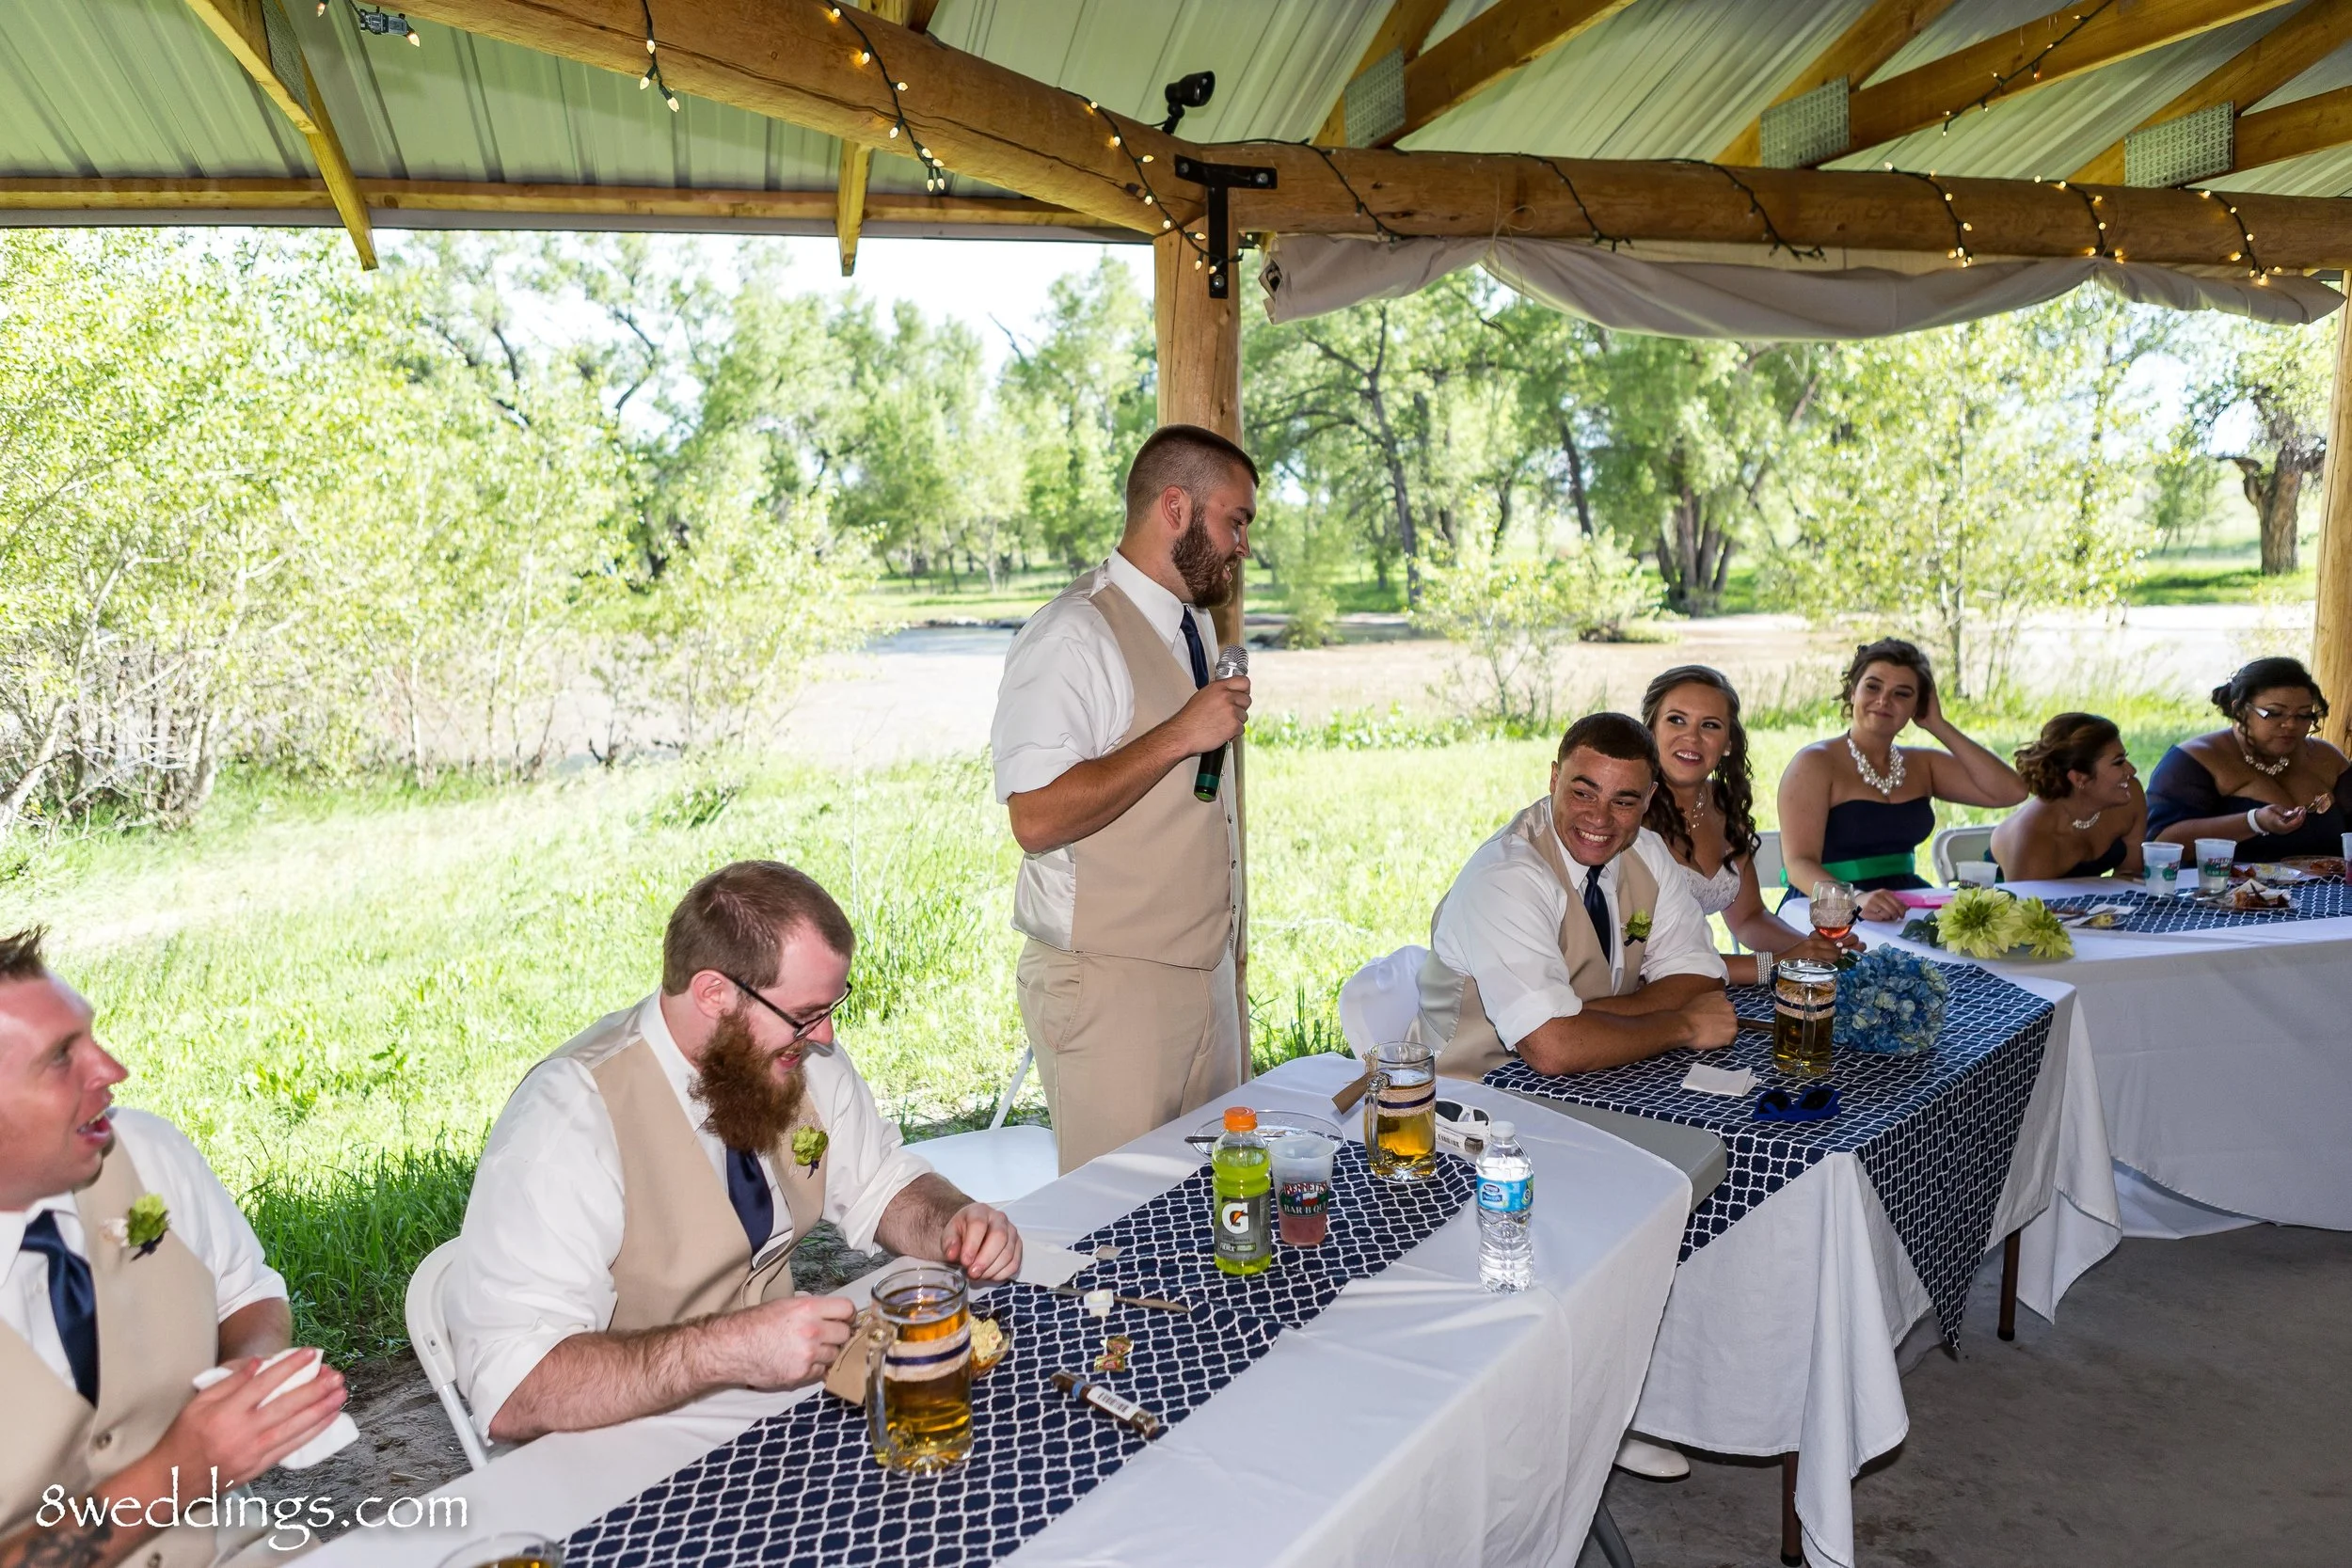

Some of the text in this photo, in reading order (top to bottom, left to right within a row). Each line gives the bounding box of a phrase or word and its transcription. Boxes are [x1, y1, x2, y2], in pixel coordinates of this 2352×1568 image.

[1222, 1202, 1249, 1234] G
[1283, 1204, 1303, 1214] BAR
[1305, 1206, 1312, 1214] B
